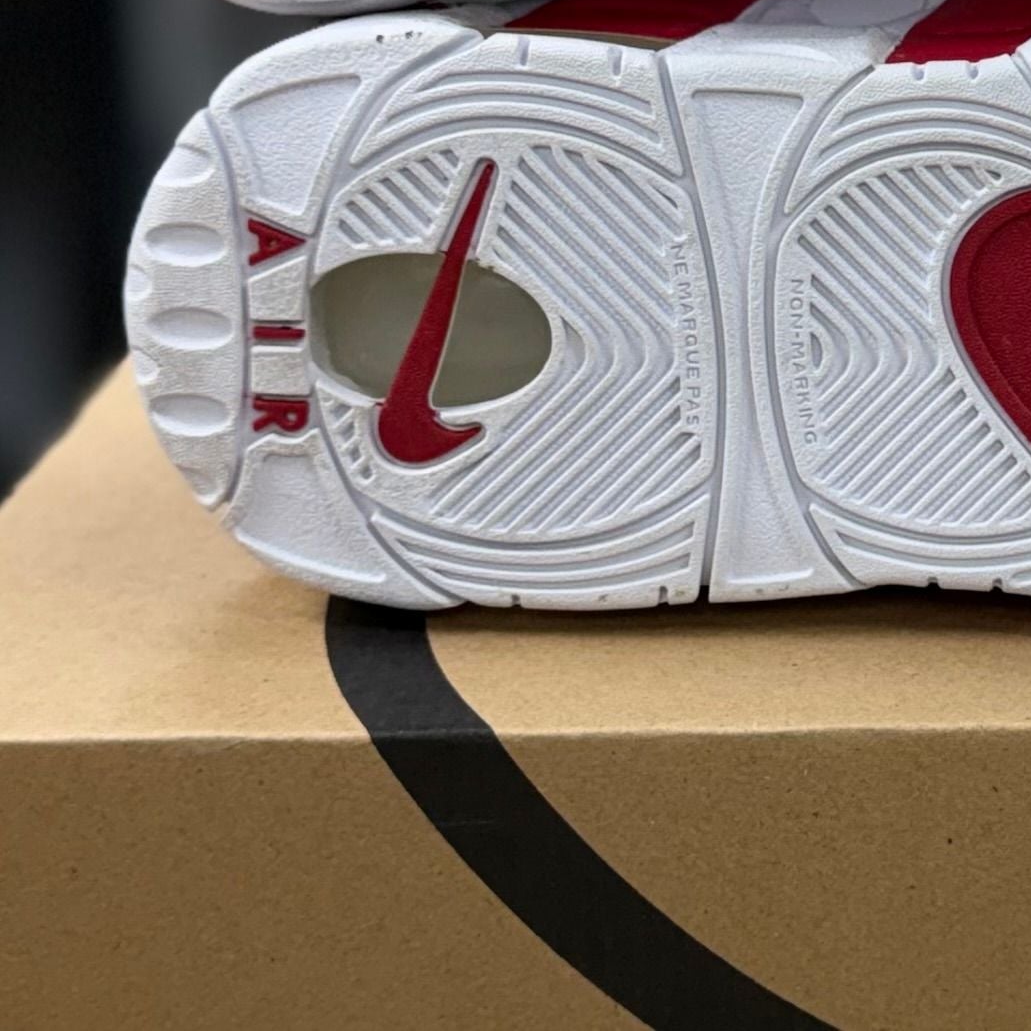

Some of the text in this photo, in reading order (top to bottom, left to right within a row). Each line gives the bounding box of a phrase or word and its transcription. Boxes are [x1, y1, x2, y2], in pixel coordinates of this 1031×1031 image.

[247, 217, 310, 433] AIR
[670, 244, 701, 425] NE MARQUE PAS
[789, 279, 818, 445] NON-MARKING
